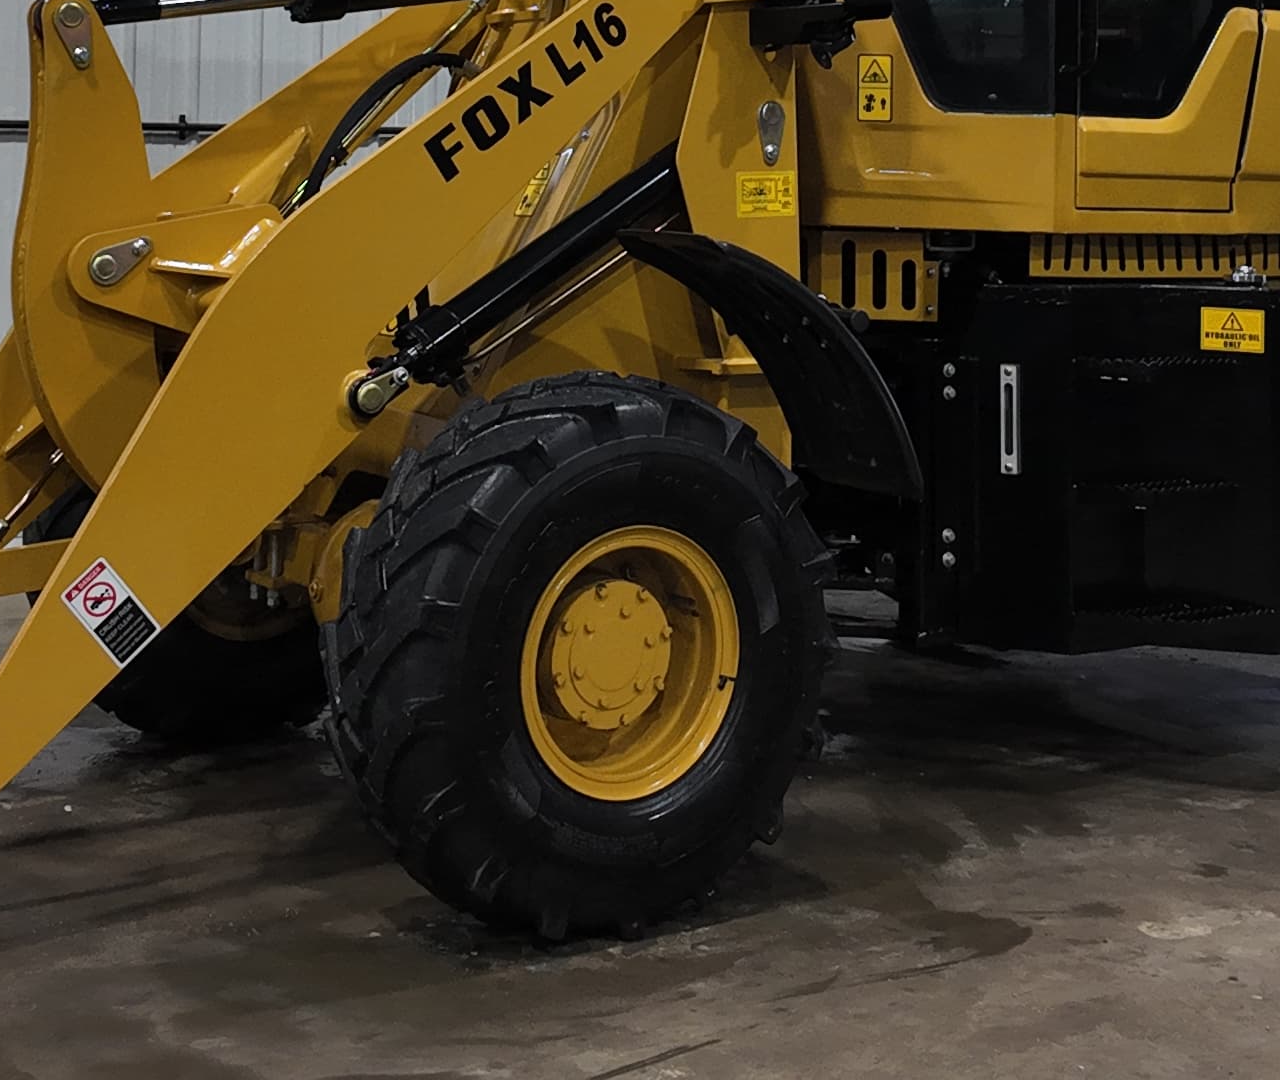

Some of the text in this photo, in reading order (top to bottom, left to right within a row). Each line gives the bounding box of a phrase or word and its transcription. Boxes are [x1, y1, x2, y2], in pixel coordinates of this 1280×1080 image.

[423, 2, 627, 183] FOX L16
[1205, 331, 1247, 341] HYDRAULIC
